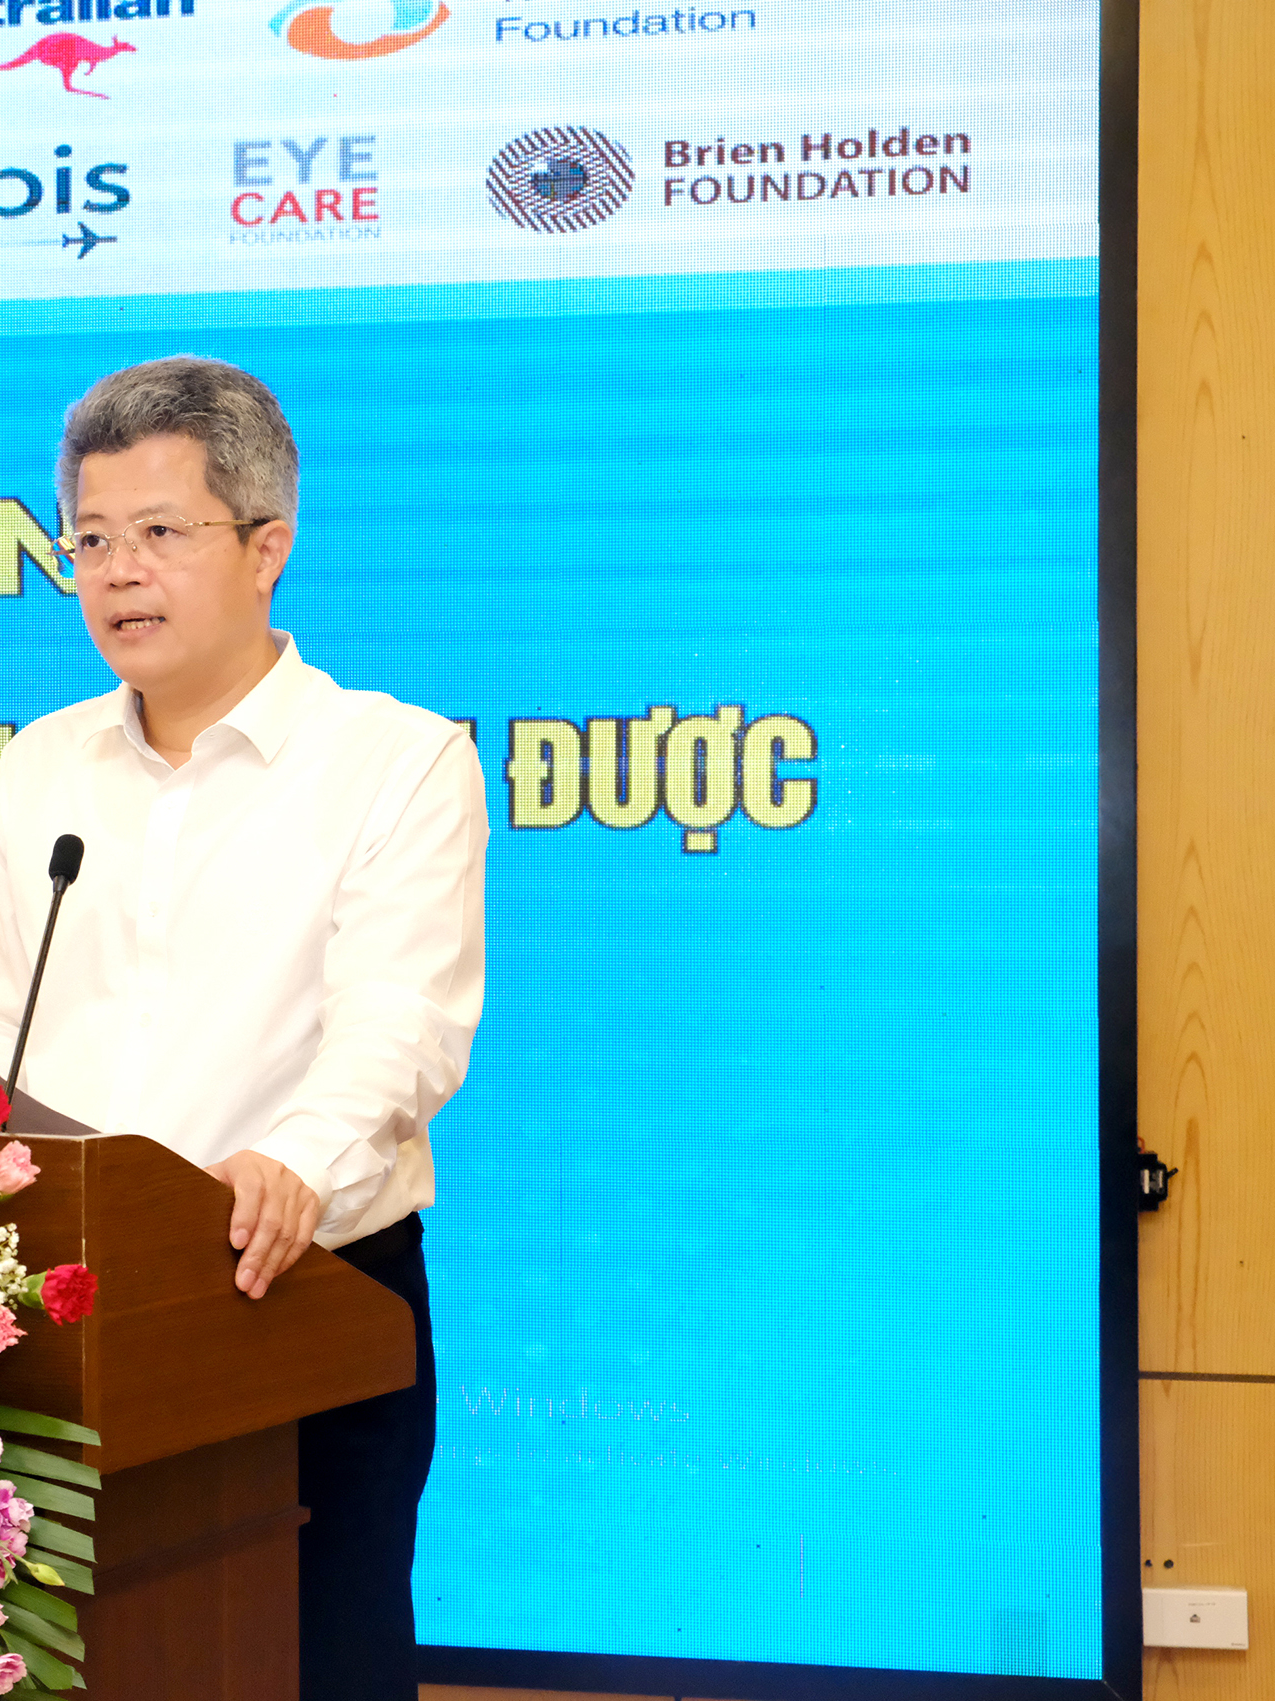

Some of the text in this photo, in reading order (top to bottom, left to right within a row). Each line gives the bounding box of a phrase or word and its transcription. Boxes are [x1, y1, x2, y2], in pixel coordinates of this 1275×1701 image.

[495, 7, 756, 42] Foundation
[233, 134, 379, 187] EYE
[664, 125, 972, 168] Brien Holden
[664, 164, 970, 206] FOUNDATION
[230, 187, 380, 228] CARE
[505, 704, 819, 854] ĐƯỢC
[459, 1384, 689, 1422] Windows
